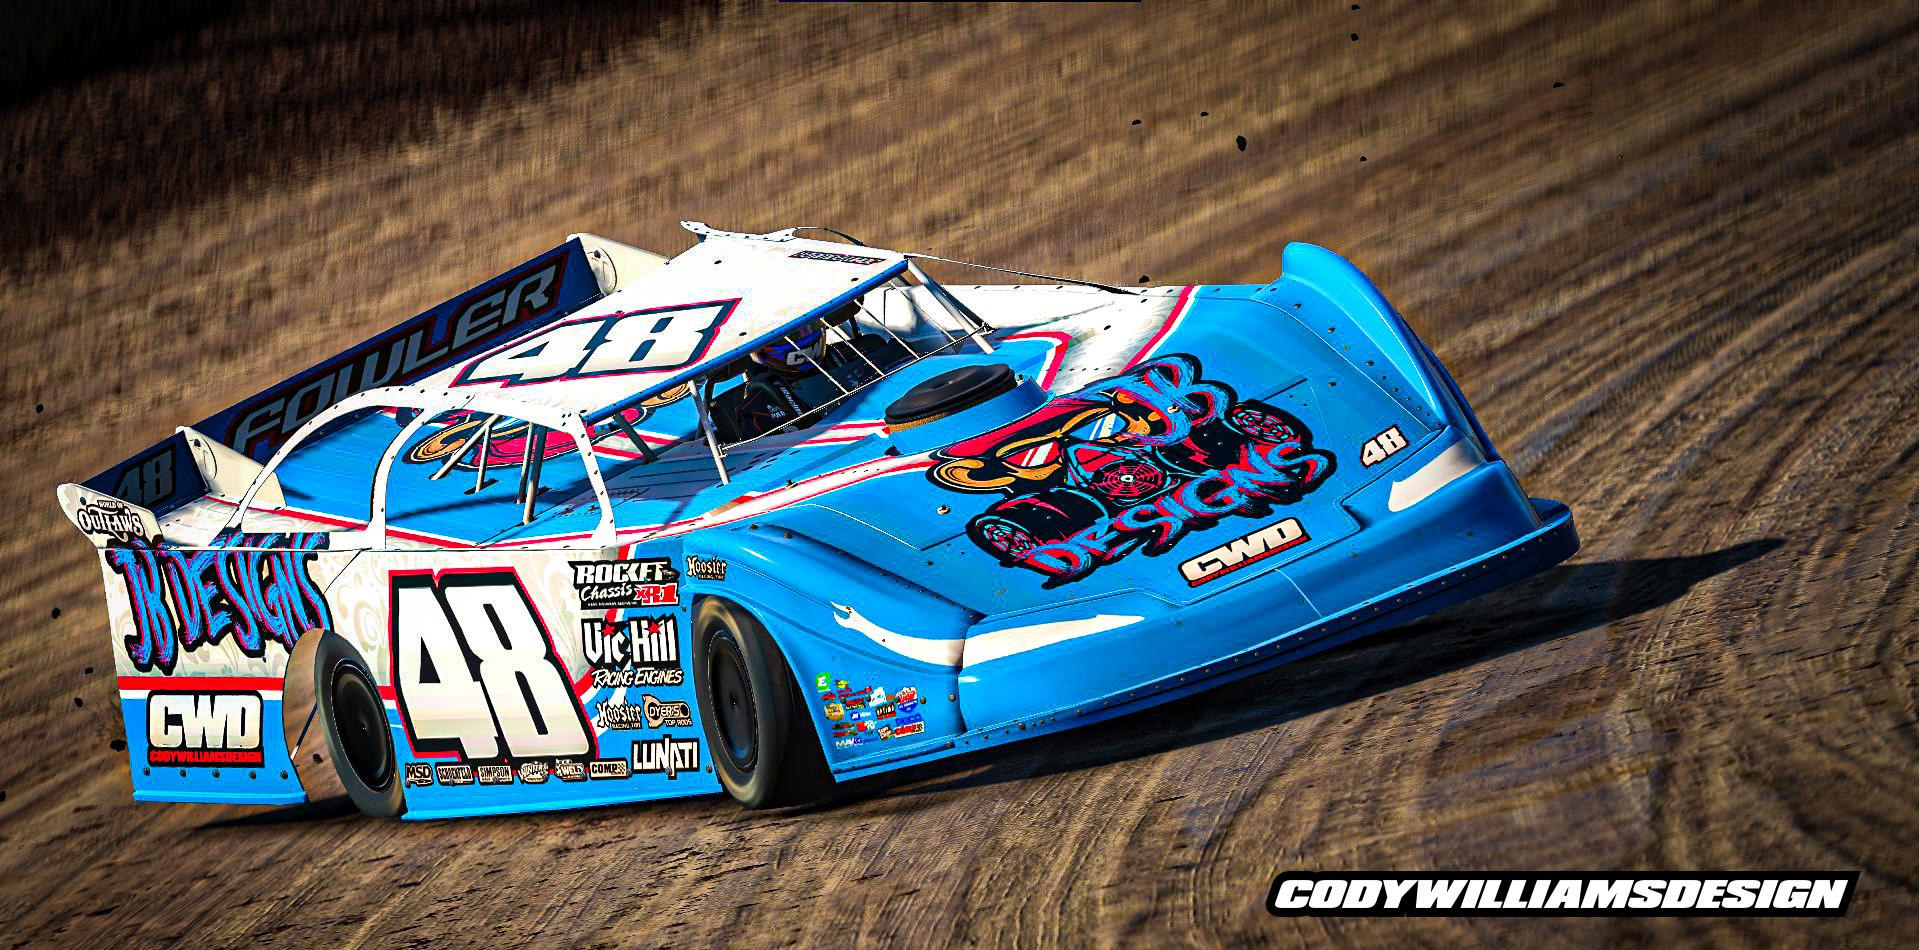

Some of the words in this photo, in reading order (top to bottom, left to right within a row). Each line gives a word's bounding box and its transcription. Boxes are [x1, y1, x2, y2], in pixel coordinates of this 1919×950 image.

[232, 264, 557, 451] FOWLER
[462, 301, 735, 385] 48
[1361, 427, 1407, 466] 48
[116, 451, 172, 507] 48
[78, 506, 144, 543] OUTLAWS
[686, 555, 728, 577] Hoosier
[1181, 518, 1304, 582] CWD
[575, 561, 668, 584] ROCKET
[581, 582, 633, 601] Chassis
[583, 622, 626, 664] Vic
[629, 617, 677, 662] Hill
[396, 583, 592, 760] 48
[149, 694, 261, 749] CWD
[596, 700, 641, 728] Hoosier
[406, 766, 432, 779] MSD
[591, 764, 618, 774] COMP
[632, 737, 698, 776] LUNATI
